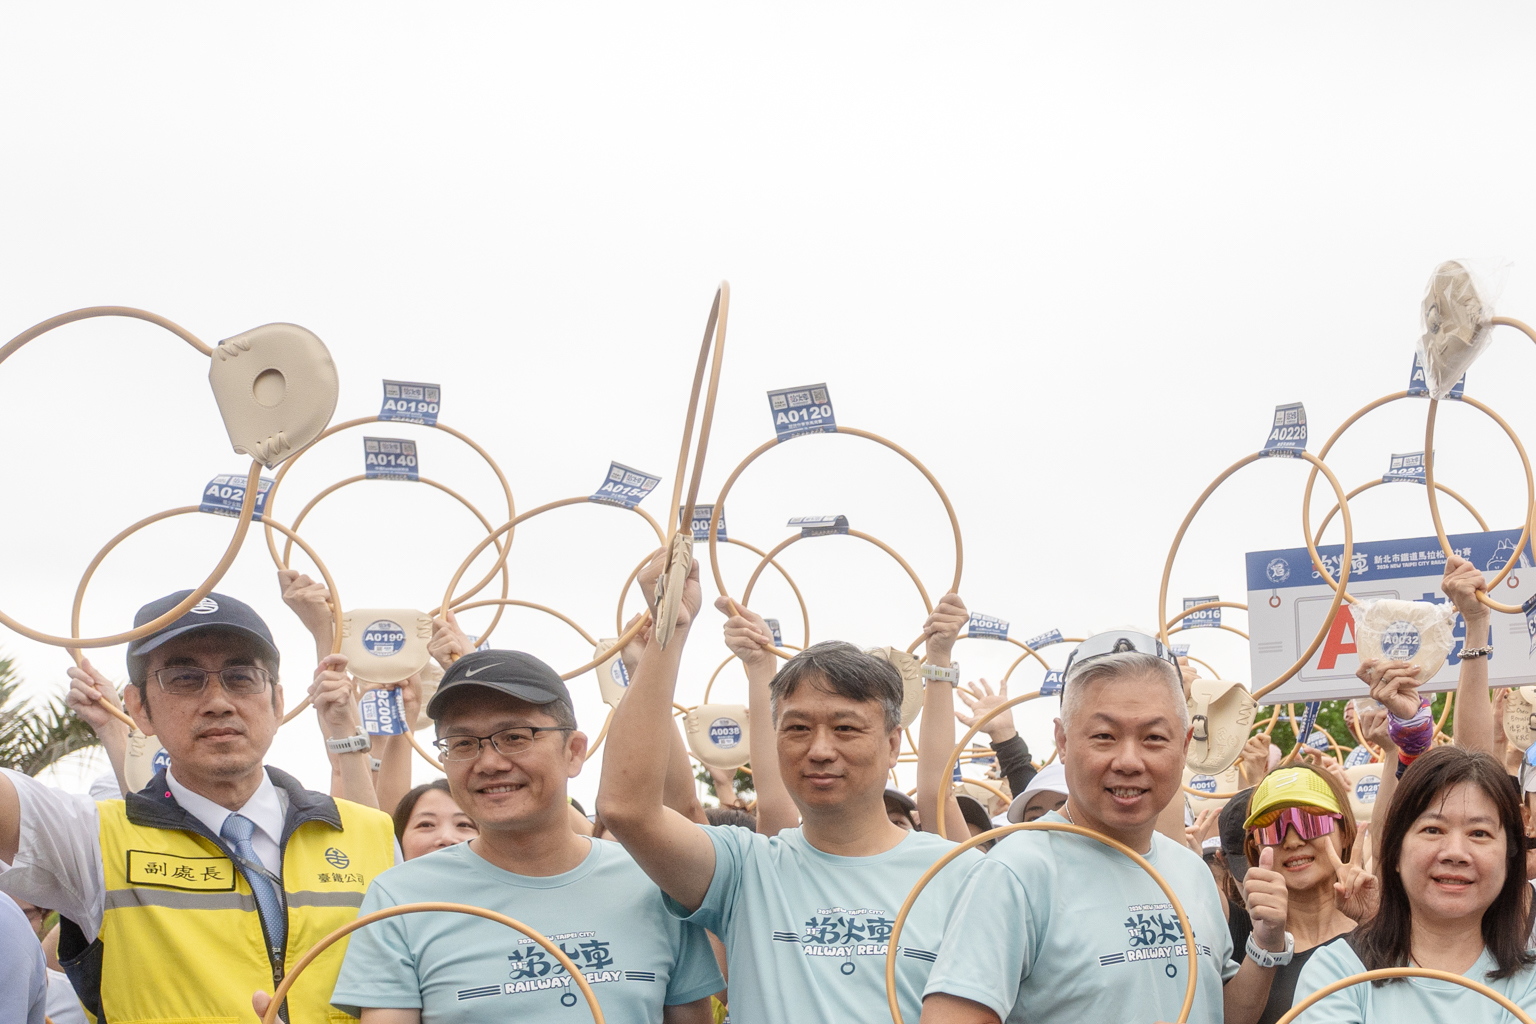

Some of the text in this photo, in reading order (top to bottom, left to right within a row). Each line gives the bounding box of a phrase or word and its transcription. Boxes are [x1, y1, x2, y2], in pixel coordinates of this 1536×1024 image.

[384, 399, 439, 414] A0190
[776, 404, 832, 425] A0120
[1269, 425, 1306, 441] A0228
[366, 453, 417, 467] A0140
[206, 484, 265, 506] A021
[601, 482, 649, 498] A0154
[1373, 547, 1472, 565] 新北市鐵道馬拉松力賽
[1184, 609, 1221, 620] A0016
[969, 619, 1008, 632] A0015
[365, 632, 404, 643] A0190
[1383, 635, 1419, 645] A0032
[380, 690, 393, 734] A0026
[710, 727, 740, 737] A0038
[1191, 781, 1216, 790] A0016
[1357, 784, 1381, 793] A028
[143, 860, 226, 882] 副處長
[317, 872, 365, 886] 臺鐵公司
[868, 908, 885, 916] CITY
[555, 932, 578, 940] TAIPEI
[1126, 944, 1202, 962] RAILWAY REY
[504, 970, 622, 995] RAILWAY ELAY
